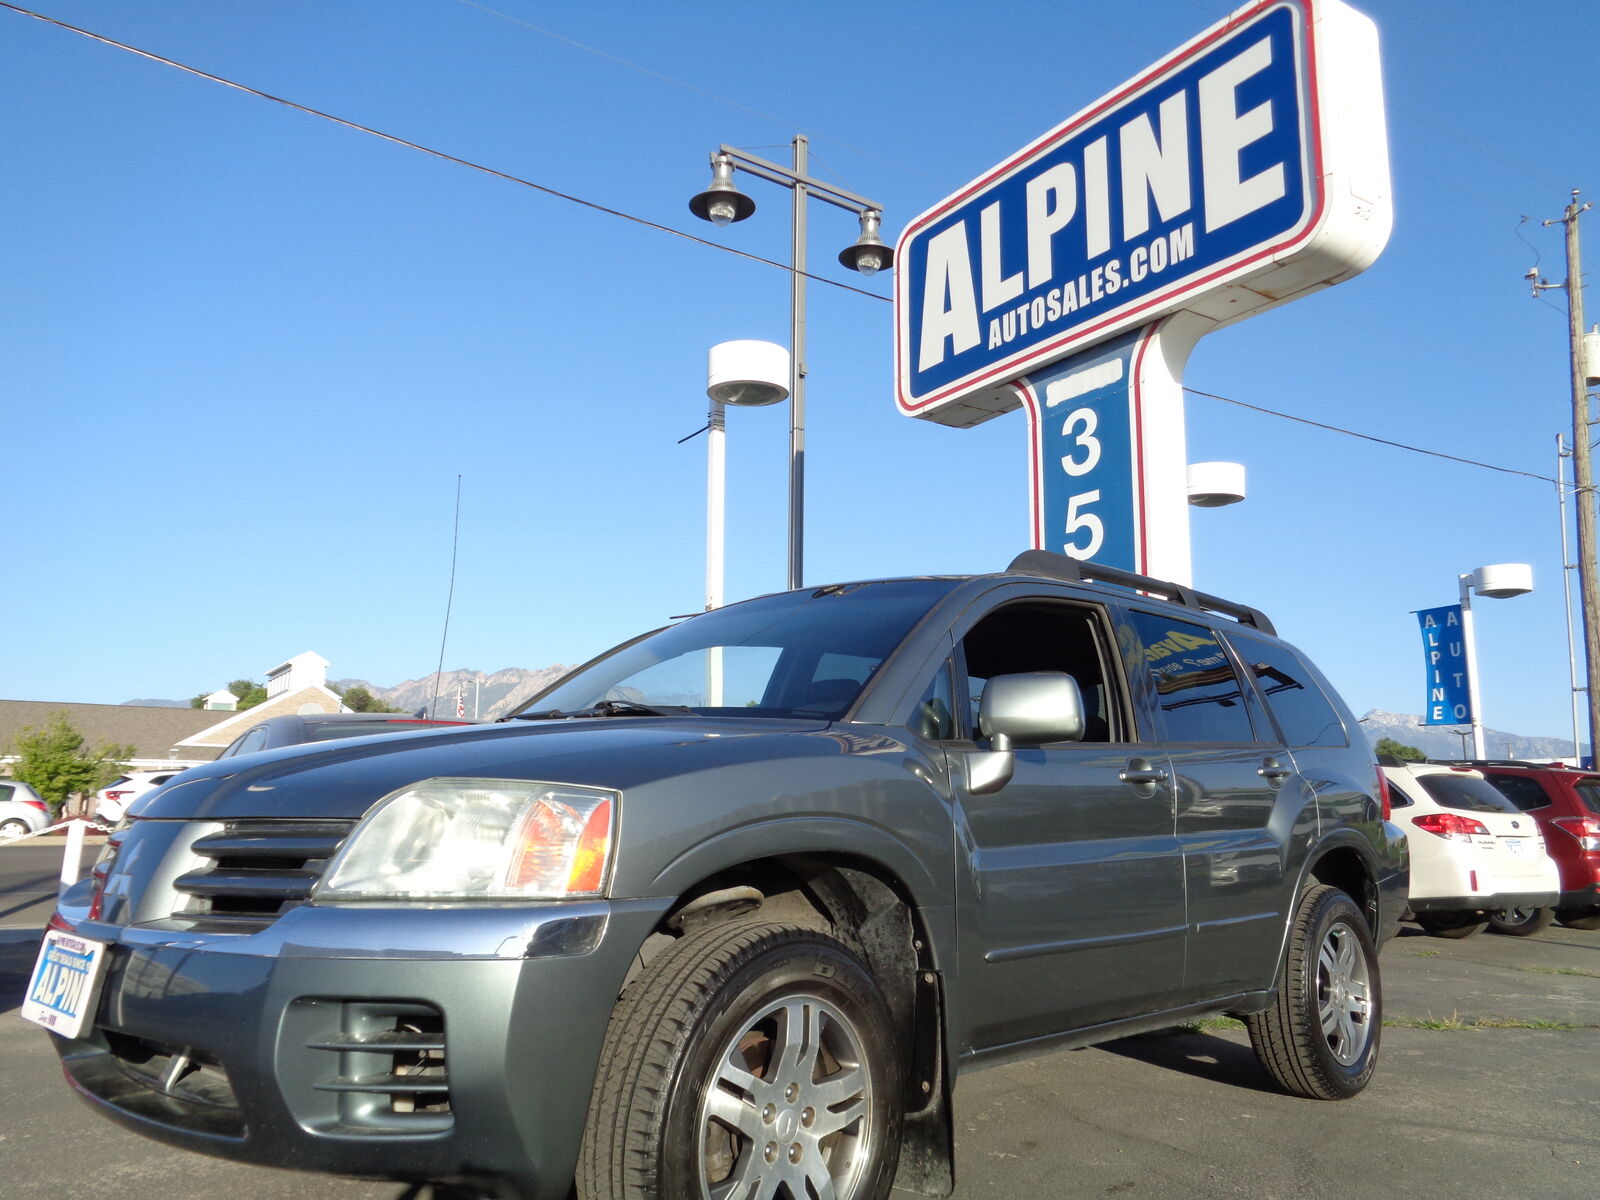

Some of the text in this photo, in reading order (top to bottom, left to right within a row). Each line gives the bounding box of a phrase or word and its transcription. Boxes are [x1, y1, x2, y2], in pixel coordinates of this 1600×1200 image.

[917, 35, 1286, 372] ALPINE
[988, 223, 1195, 350] AUTOSALES.COM
[1425, 614, 1444, 720] ALPINE
[1446, 611, 1467, 719] AUTO
